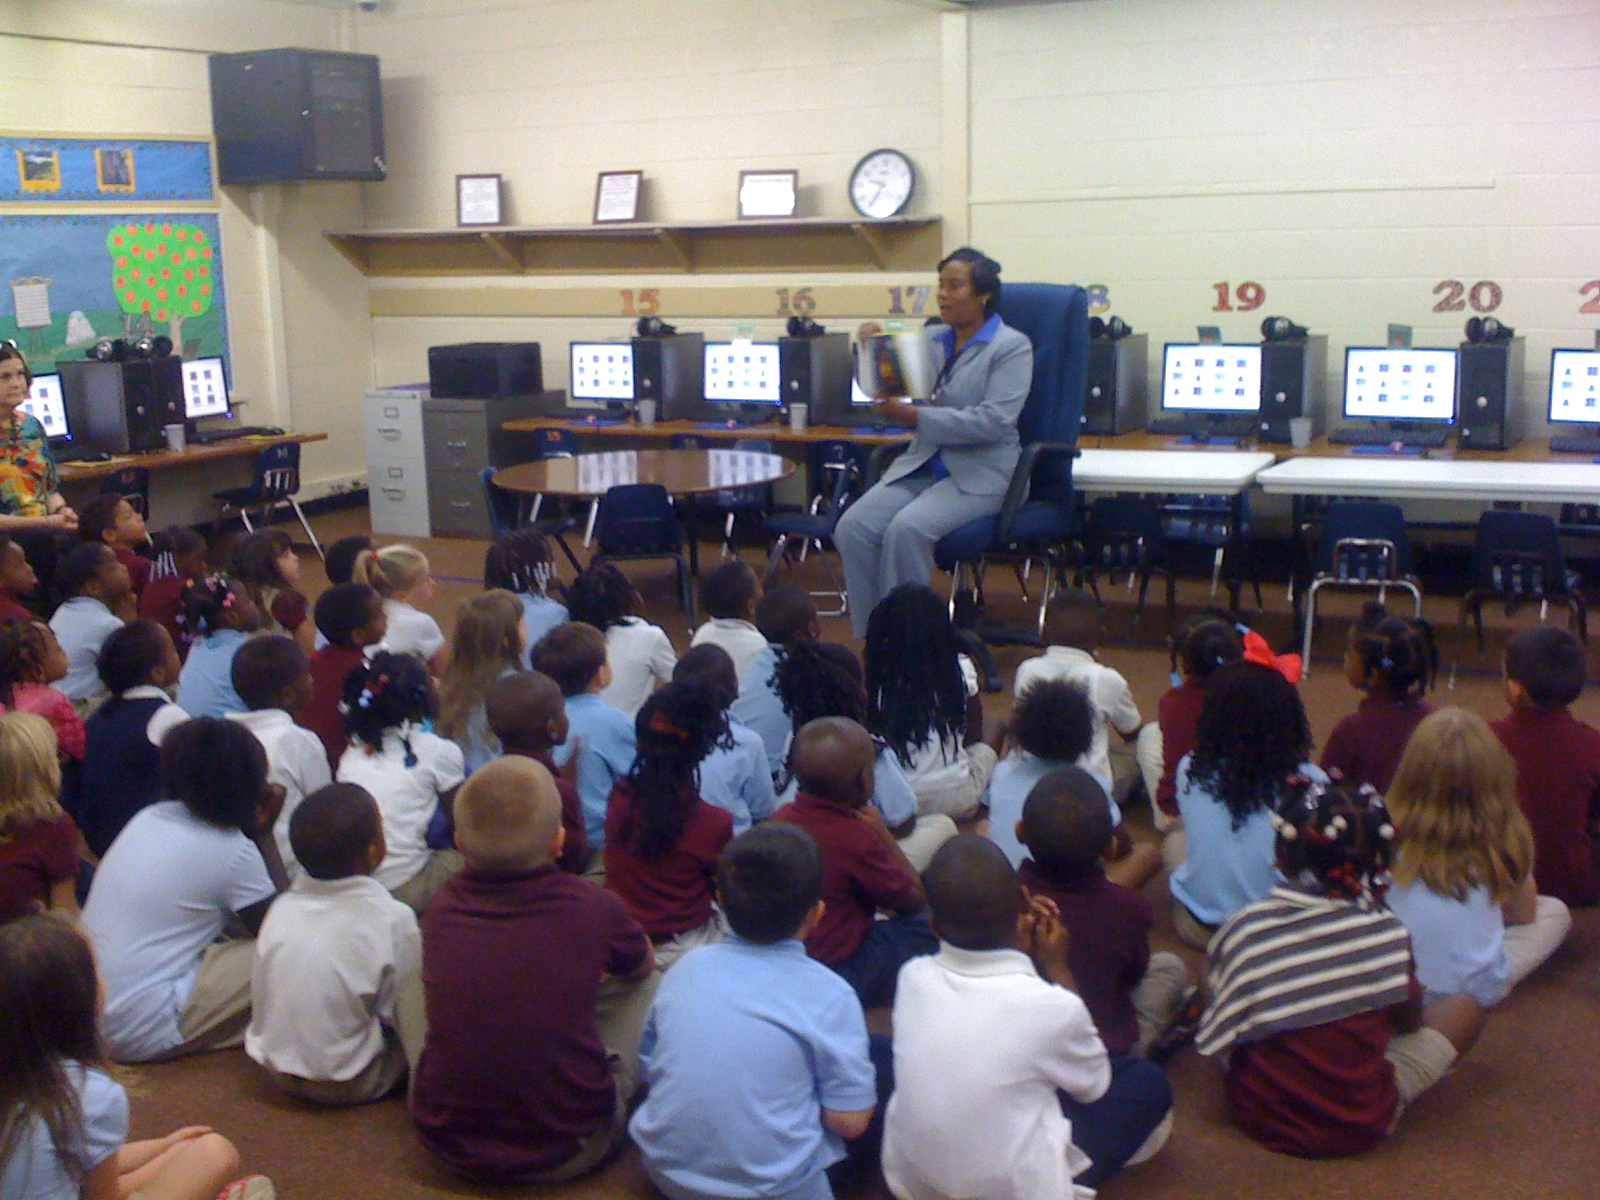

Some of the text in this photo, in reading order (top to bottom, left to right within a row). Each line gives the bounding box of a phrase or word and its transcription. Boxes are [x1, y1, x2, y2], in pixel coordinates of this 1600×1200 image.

[620, 288, 660, 315] 15
[775, 287, 816, 316] 16
[888, 286, 930, 314] 17
[1086, 284, 1111, 314] 8
[1212, 281, 1266, 312] 19
[1432, 280, 1503, 313] 20
[1578, 280, 1600, 313] 2
